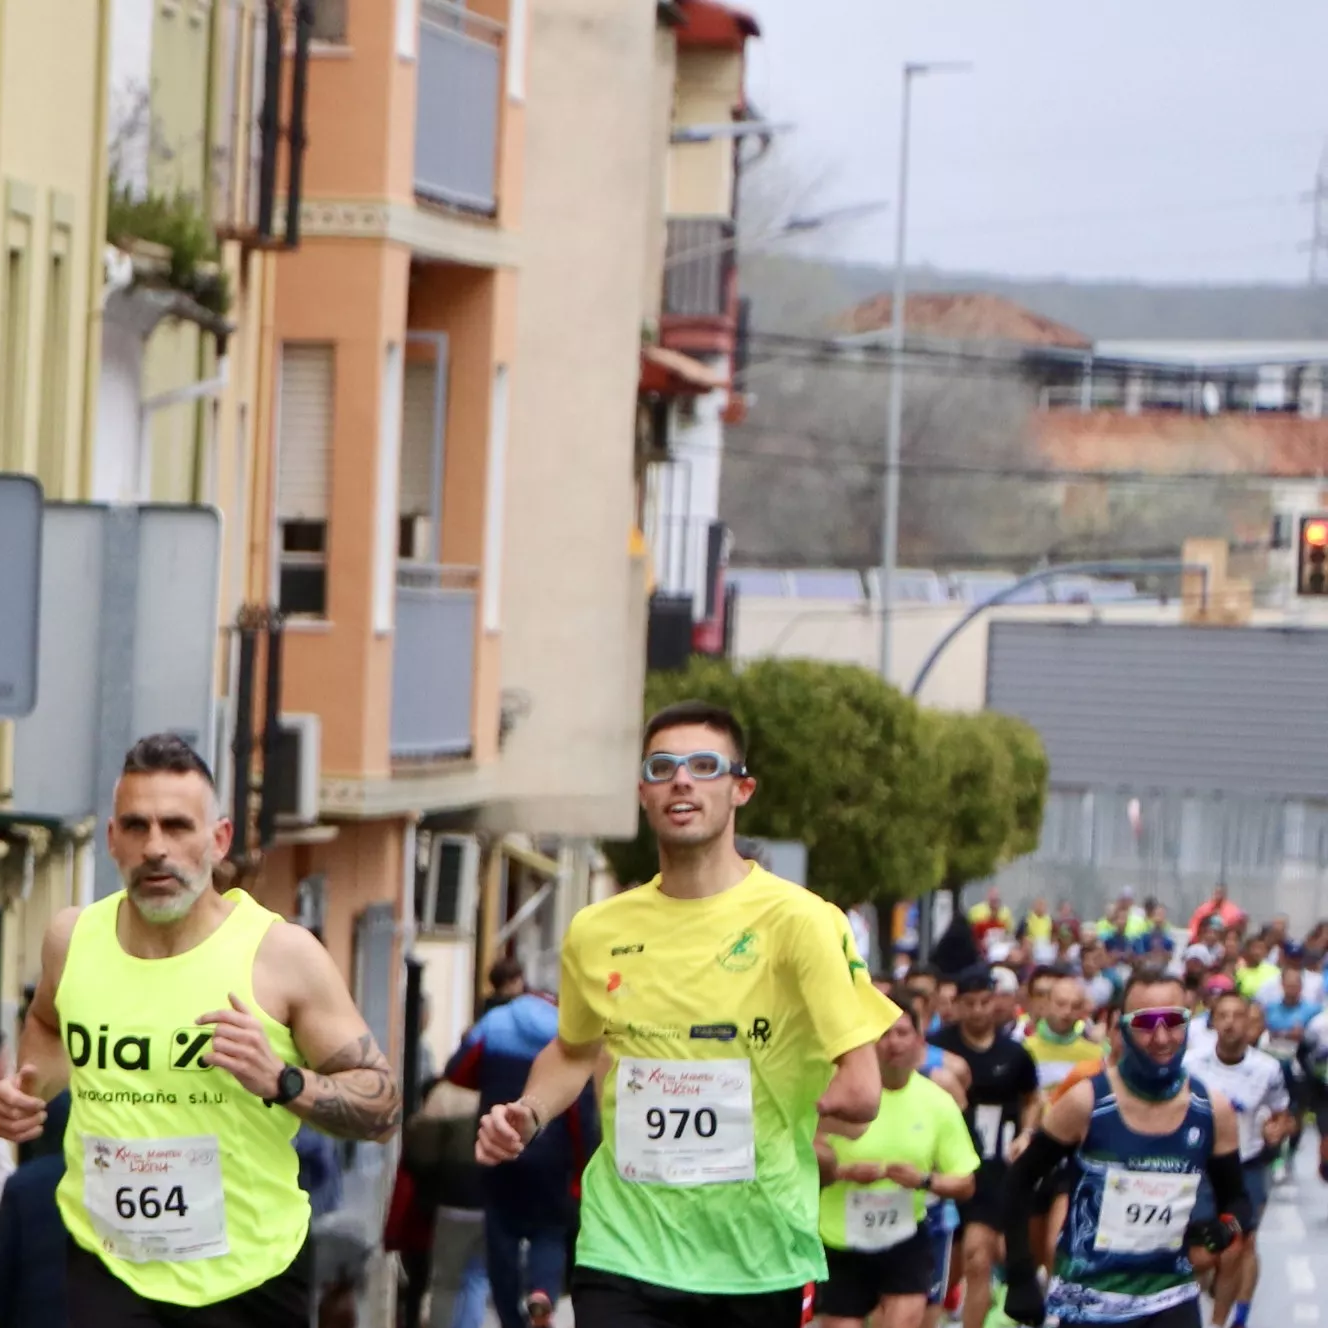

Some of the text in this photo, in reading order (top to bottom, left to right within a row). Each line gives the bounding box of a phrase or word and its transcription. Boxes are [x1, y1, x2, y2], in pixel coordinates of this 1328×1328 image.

[67, 1021, 151, 1071] Dia
[646, 1107, 718, 1140] 970
[115, 1185, 189, 1219] 664
[1126, 1203, 1172, 1227] 974
